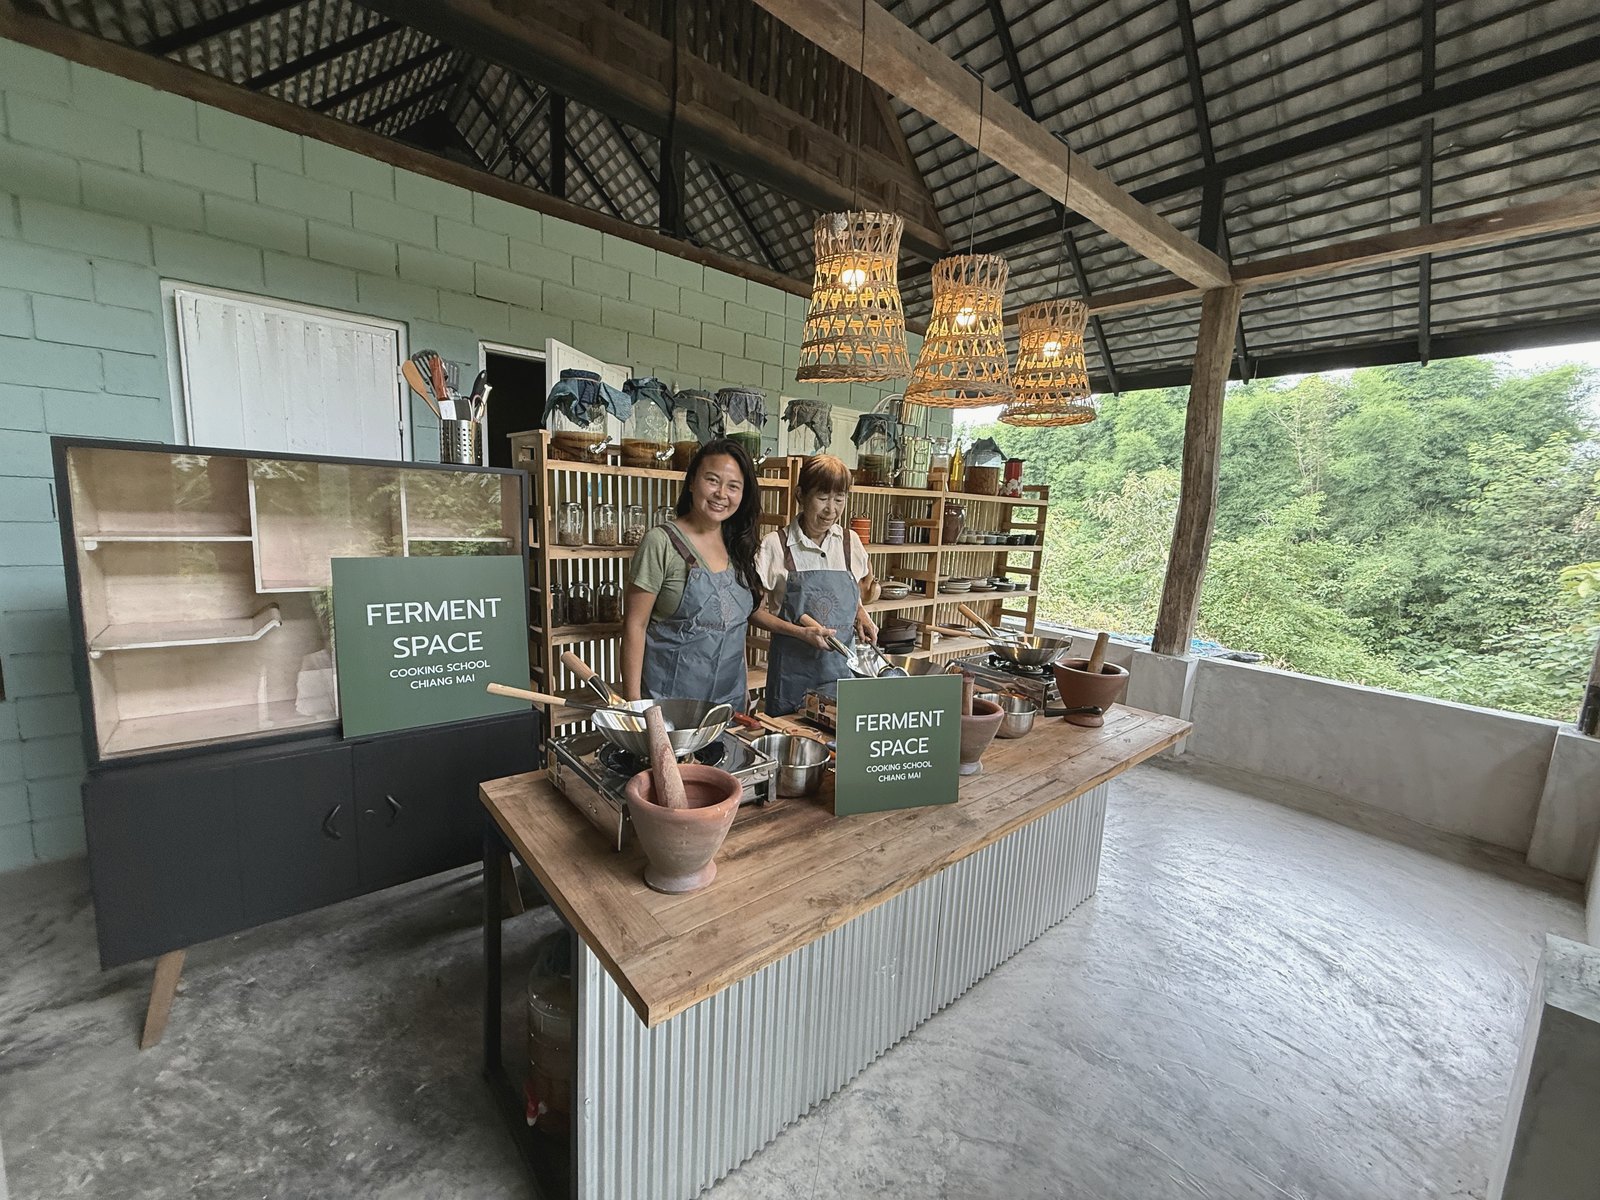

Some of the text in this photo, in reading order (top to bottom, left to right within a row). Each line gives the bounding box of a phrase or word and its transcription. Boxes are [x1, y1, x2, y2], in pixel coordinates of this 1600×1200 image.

[366, 597, 502, 626] FERMENT
[393, 630, 484, 659] SPACE
[389, 659, 491, 679] COOKING SCHOOL
[410, 673, 475, 690] CHIANG MAI
[855, 710, 945, 733] FERMENT
[869, 737, 929, 758] SPACE
[866, 760, 932, 773] COOKING SCHOOL
[878, 772, 921, 783] CHIANG MAI
